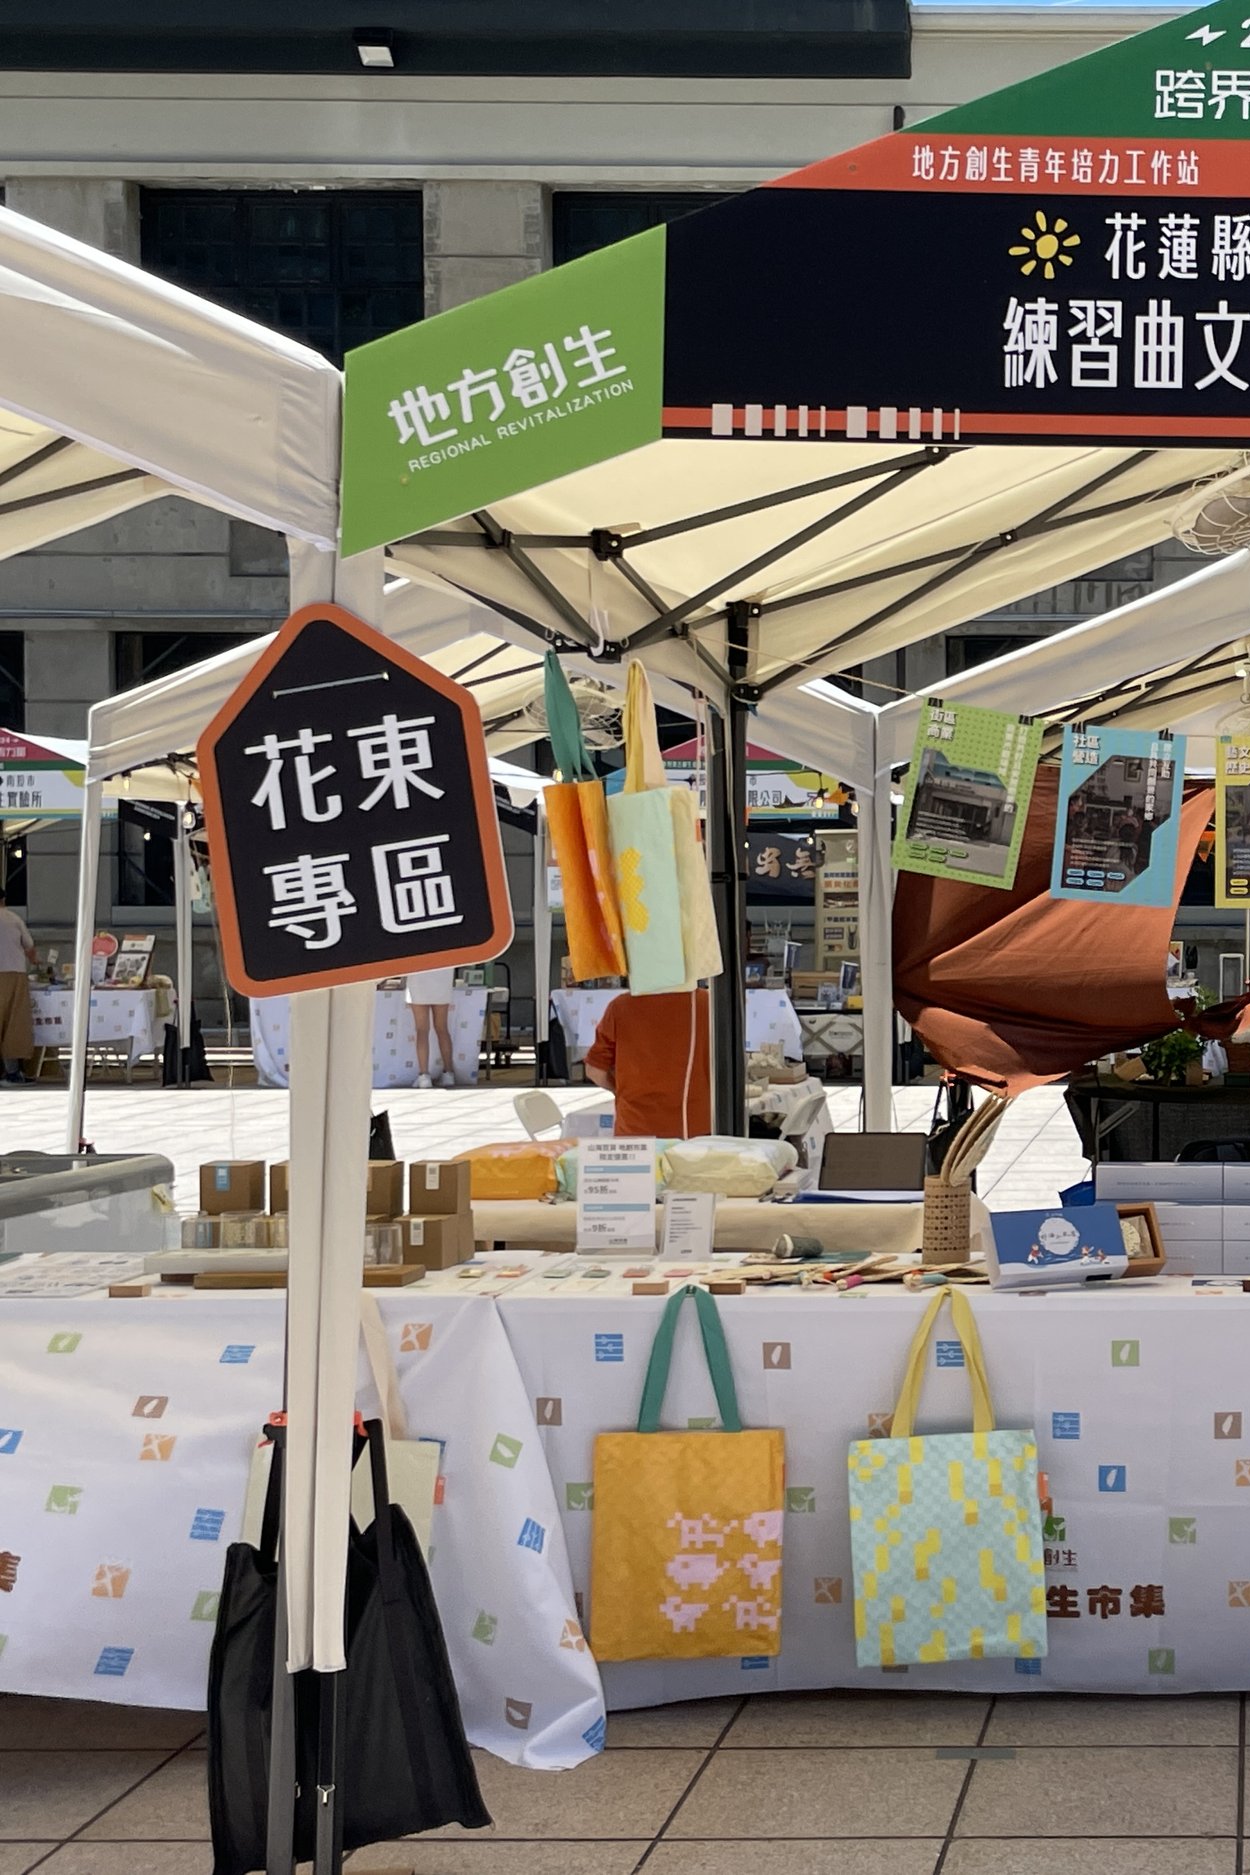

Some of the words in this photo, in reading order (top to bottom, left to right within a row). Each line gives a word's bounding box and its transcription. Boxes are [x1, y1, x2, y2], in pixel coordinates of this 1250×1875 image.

[912, 145, 1200, 186] 地方創生青年培力工作站
[387, 325, 627, 446] 地方創生
[408, 433, 492, 472] REGIONAL
[497, 379, 634, 439] REVITALIZATION
[244, 714, 445, 830] 花東
[1073, 733, 1100, 750] 社區
[263, 834, 464, 950] 專區
[1046, 1584, 1165, 1619] 生市集
